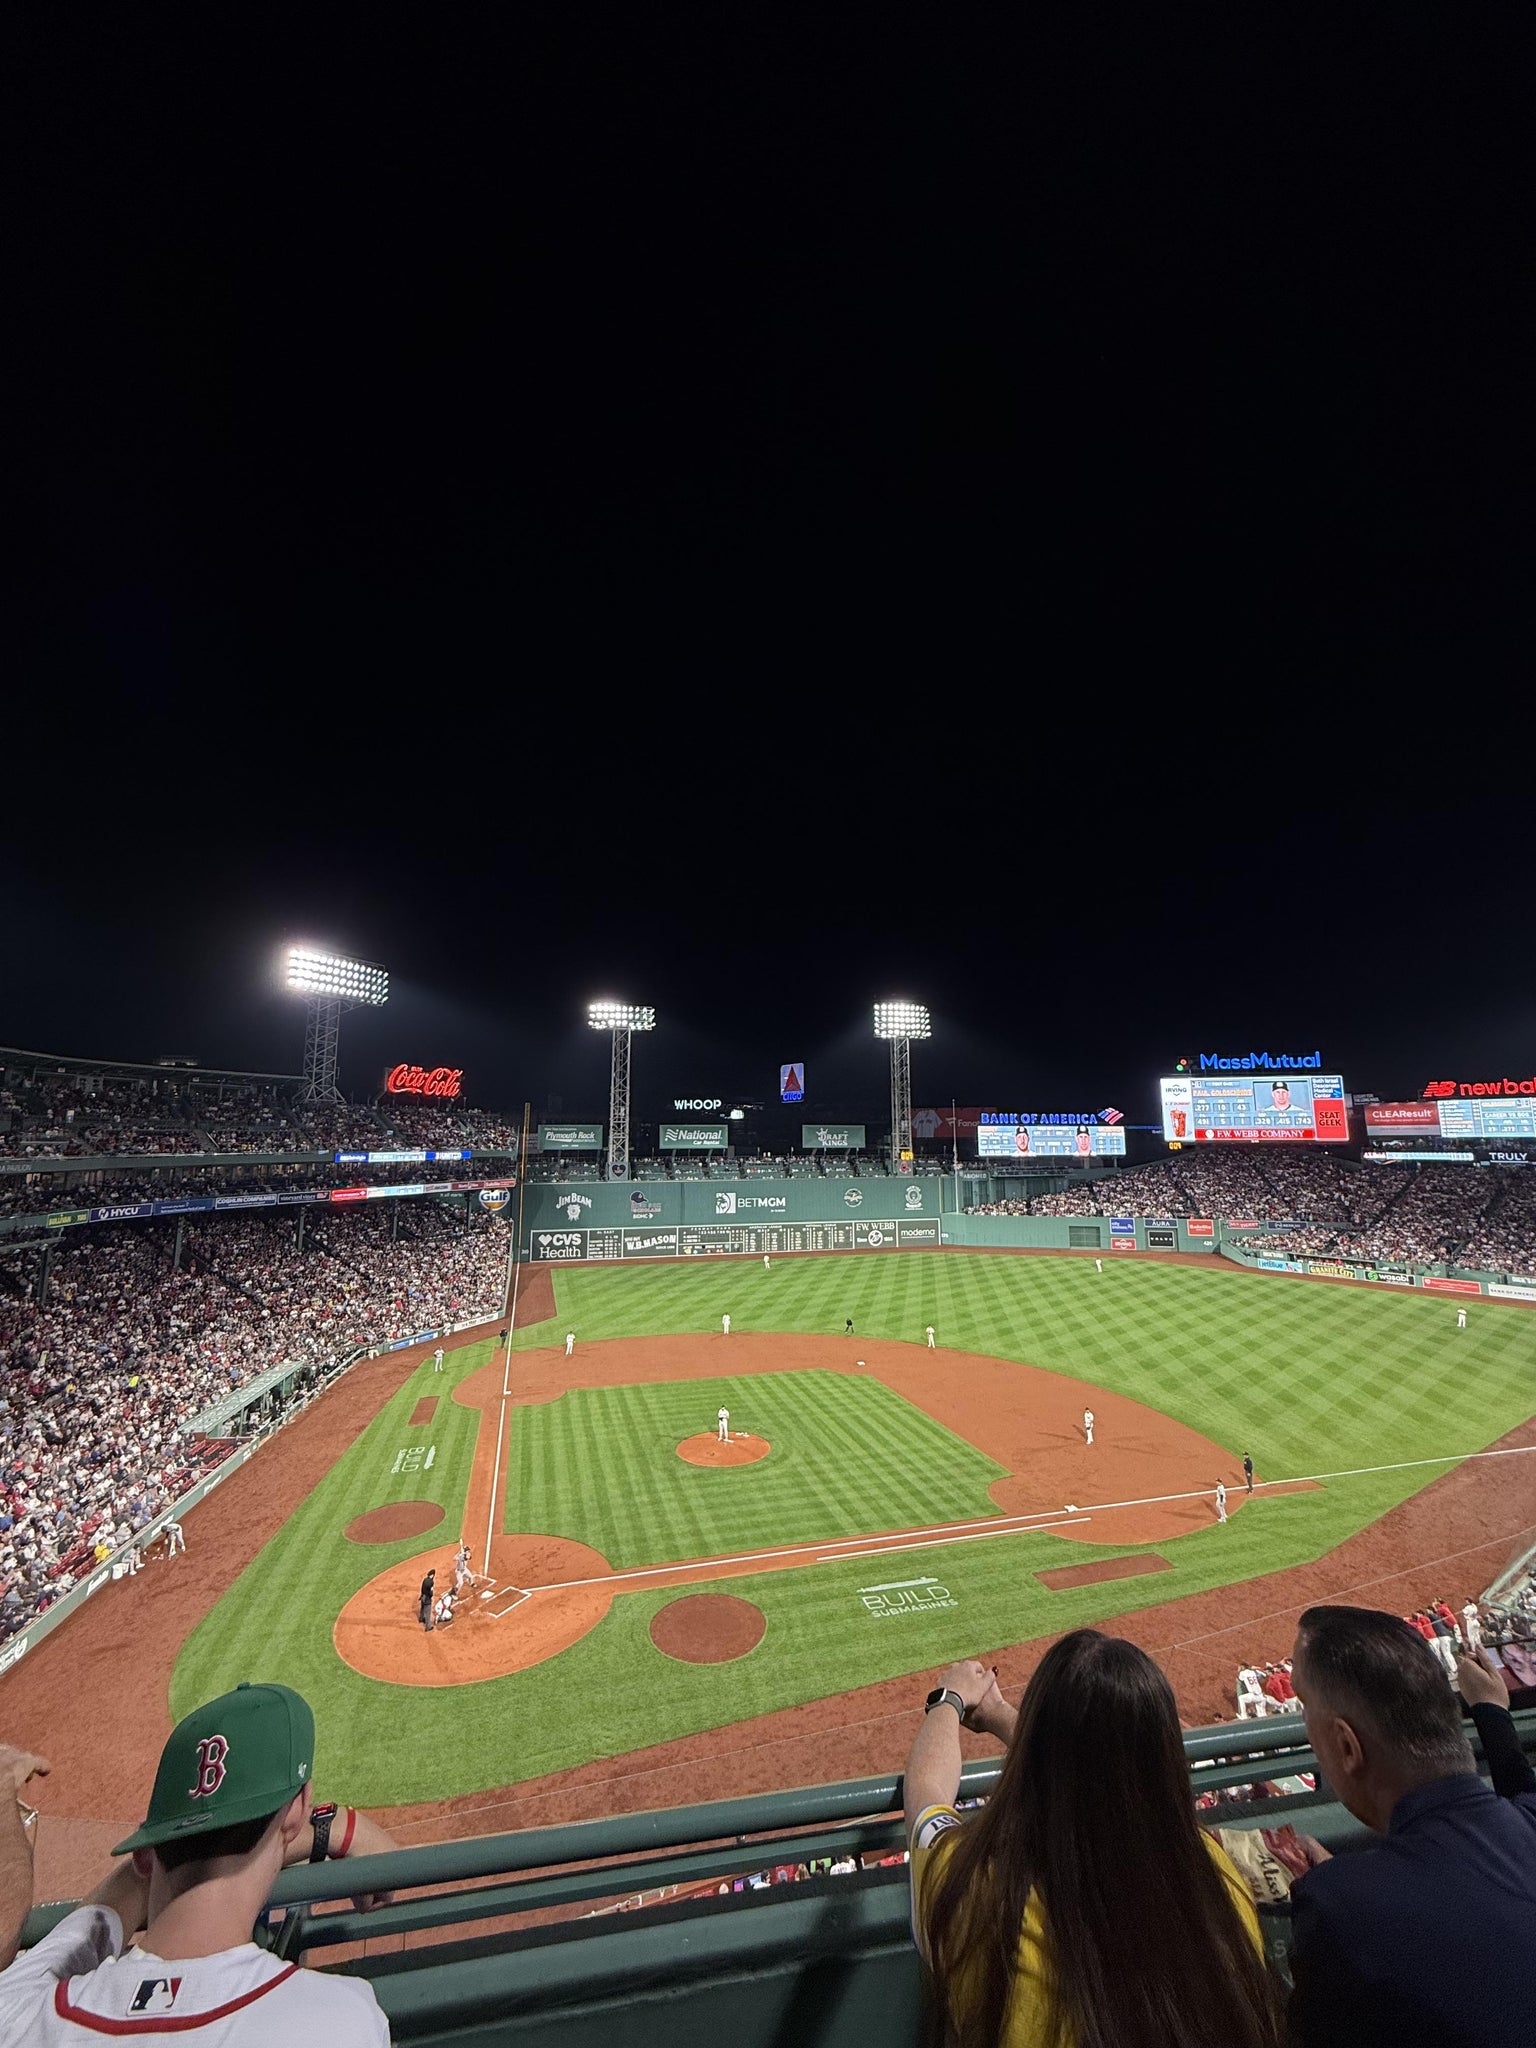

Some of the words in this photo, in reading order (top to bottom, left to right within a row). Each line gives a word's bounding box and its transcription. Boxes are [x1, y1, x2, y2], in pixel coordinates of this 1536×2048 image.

[1199, 1050, 1321, 1070] MassMutual
[388, 1064, 463, 1097] Coca-Cola
[674, 1099, 722, 1110] WHOOP
[981, 1113, 1019, 1124] BANK
[1020, 1113, 1038, 1124] OF
[1039, 1113, 1098, 1125] AMERICA
[1372, 1109, 1433, 1118] CLEAResult
[546, 1131, 577, 1141] Plymouth
[578, 1131, 595, 1139] Rock
[678, 1129, 723, 1140] National
[1260, 1129, 1305, 1137] COMPANY
[1488, 1152, 1528, 1161] TRULY
[480, 1191, 508, 1201] Gulf
[555, 1195, 571, 1209] JIM
[571, 1192, 592, 1209] BEAM
[737, 1197, 786, 1208] BETMGM
[110, 1206, 139, 1217] HYCU
[871, 1222, 895, 1231] WEBB
[900, 1228, 936, 1237] moderna
[552, 1233, 582, 1246] CVS
[538, 1246, 581, 1259] Health
[1261, 1261, 1284, 1269] jetBlue
[1310, 1266, 1340, 1276] GRANITE
[1339, 1268, 1355, 1279] CITY
[1379, 1274, 1409, 1282] wasabi
[861, 1586, 950, 1610] BUILD
[871, 1598, 959, 1618] SUBMARINES
[189, 1734, 230, 1799] B
